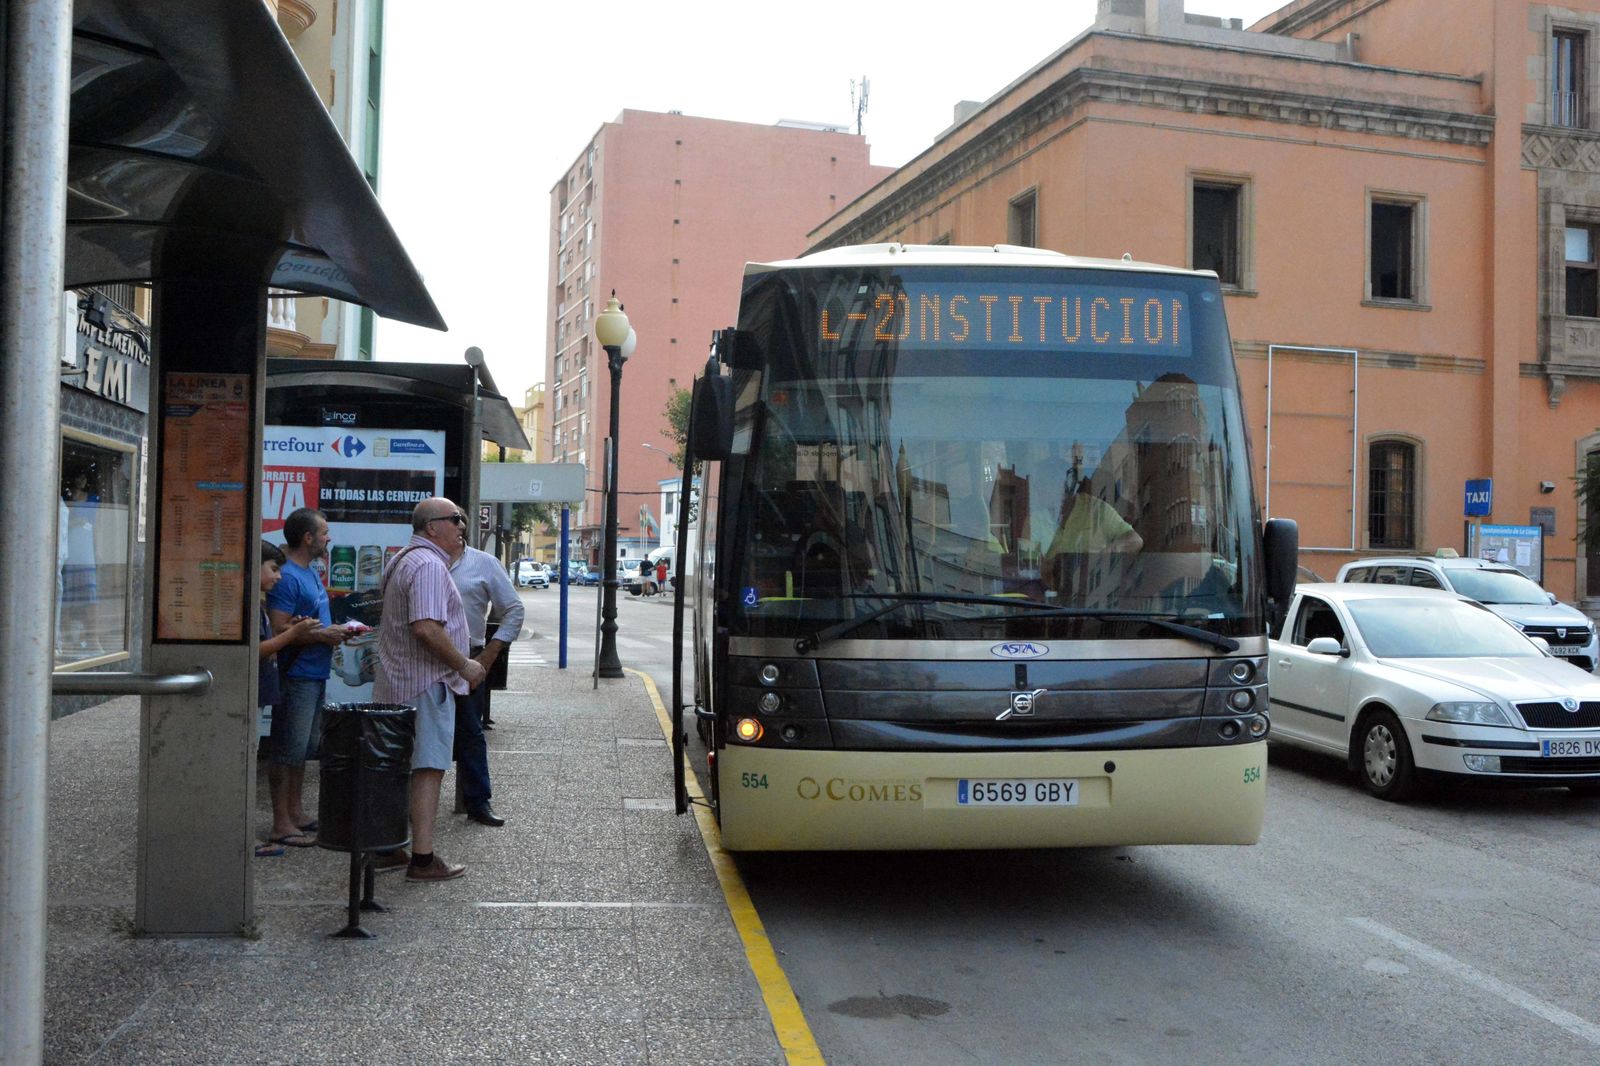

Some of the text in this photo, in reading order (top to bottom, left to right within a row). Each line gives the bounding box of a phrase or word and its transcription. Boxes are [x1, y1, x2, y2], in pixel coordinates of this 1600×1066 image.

[86, 346, 132, 404] EMI
[297, 473, 306, 482] EL
[320, 488, 432, 503] EN TODAS LAS CERVEZAS
[1466, 491, 1488, 503] TAXI
[1551, 741, 1580, 755] 8826
[742, 773, 769, 789] 554
[1244, 767, 1261, 784] 554
[972, 780, 1027, 802] 6569
[1035, 779, 1074, 802] GBY
